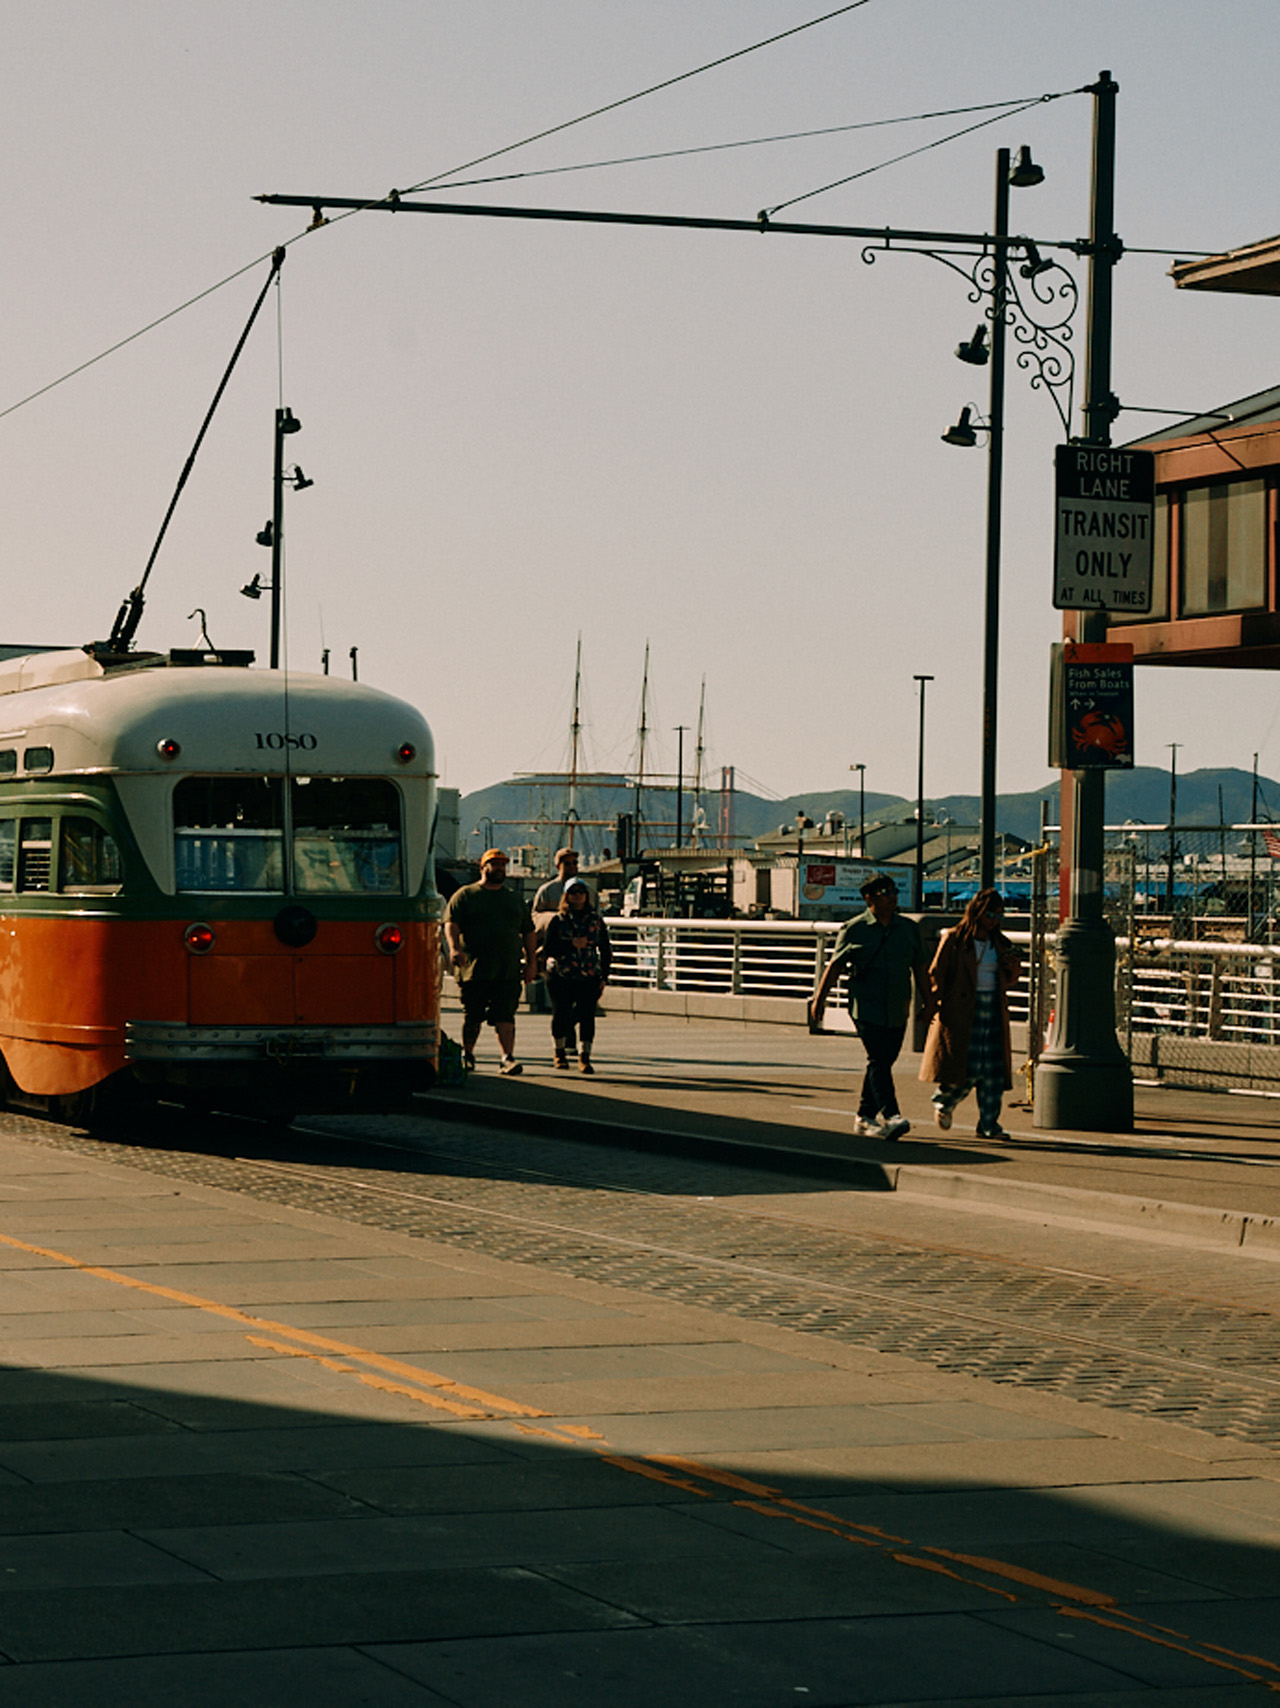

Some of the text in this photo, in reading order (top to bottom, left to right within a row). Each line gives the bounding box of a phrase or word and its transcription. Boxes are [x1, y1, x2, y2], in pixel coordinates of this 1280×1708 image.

[1076, 451, 1134, 474] RIGHT
[1080, 477, 1131, 499] LANE
[1061, 510, 1149, 540] TRANSIT
[1076, 550, 1132, 578] ONLY
[1061, 587, 1145, 605] AT ALL TIMES
[1068, 667, 1122, 679] Fish Sales
[1068, 679, 1130, 690] From Boats
[254, 732, 317, 750] 1080
